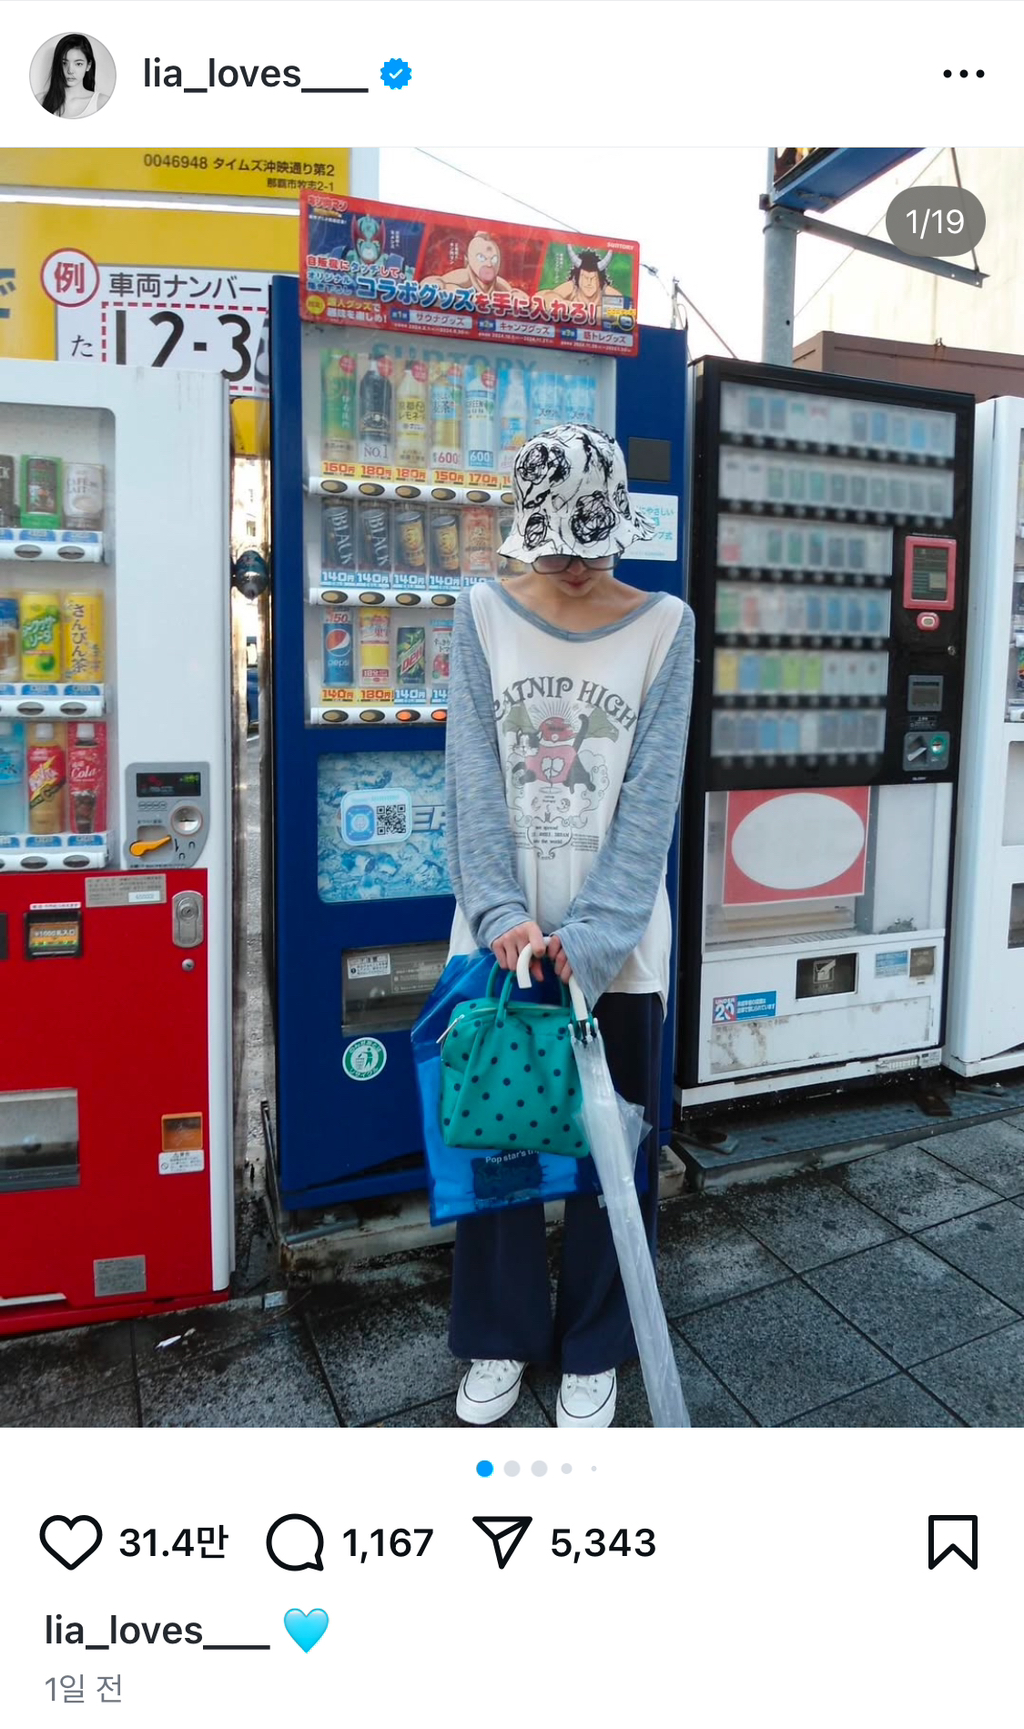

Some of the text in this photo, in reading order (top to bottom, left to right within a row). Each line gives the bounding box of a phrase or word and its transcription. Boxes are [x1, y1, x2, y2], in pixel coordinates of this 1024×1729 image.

[143, 153, 335, 177] 0046948 タイムズ沖映通り第2
[54, 262, 85, 294] 例
[109, 272, 262, 299] 車両ナンバー
[416, 313, 465, 326] サウナグッズ
[71, 334, 94, 357] た
[470, 452, 491, 462] 600
[435, 470, 464, 482] 150円
[469, 473, 498, 485] 170円
[331, 513, 354, 565] BLACK
[367, 514, 391, 567] BLACK
[322, 571, 355, 582] 140円
[357, 572, 390, 583] 140円
[395, 574, 425, 585] 140円
[430, 575, 460, 586] 140円
[327, 659, 350, 668] pepsi
[396, 689, 425, 699] 140円
[493, 676, 638, 732] CATNIP HIGH
[71, 765, 97, 779] Cola
[715, 1002, 735, 1021] 20
[485, 1155, 502, 1164] Pop
[503, 1149, 527, 1162] star's
